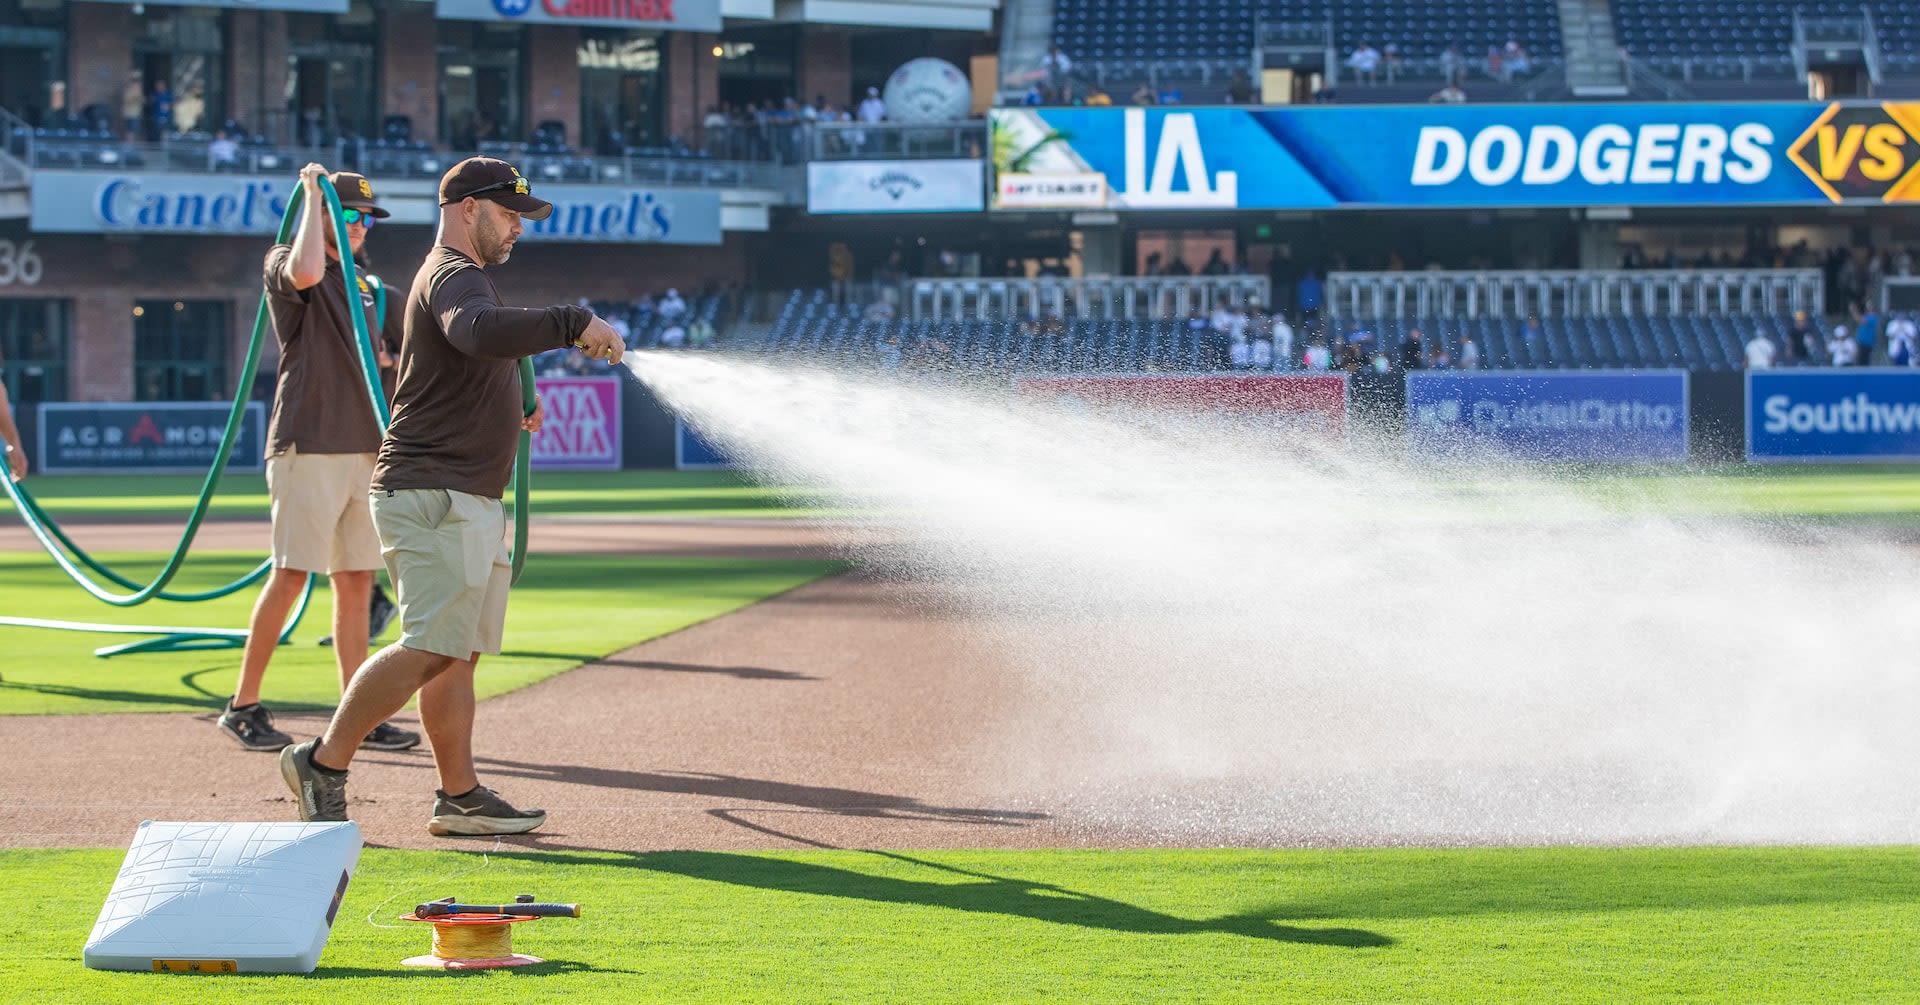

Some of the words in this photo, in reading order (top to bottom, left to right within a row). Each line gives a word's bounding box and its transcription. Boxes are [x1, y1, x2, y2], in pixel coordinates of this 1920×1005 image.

[1119, 107, 1237, 209] LA
[1410, 123, 1774, 187] DODGERS
[1817, 123, 1907, 182] VS
[99, 176, 288, 228] Canel's
[1764, 392, 1920, 433] Southw
